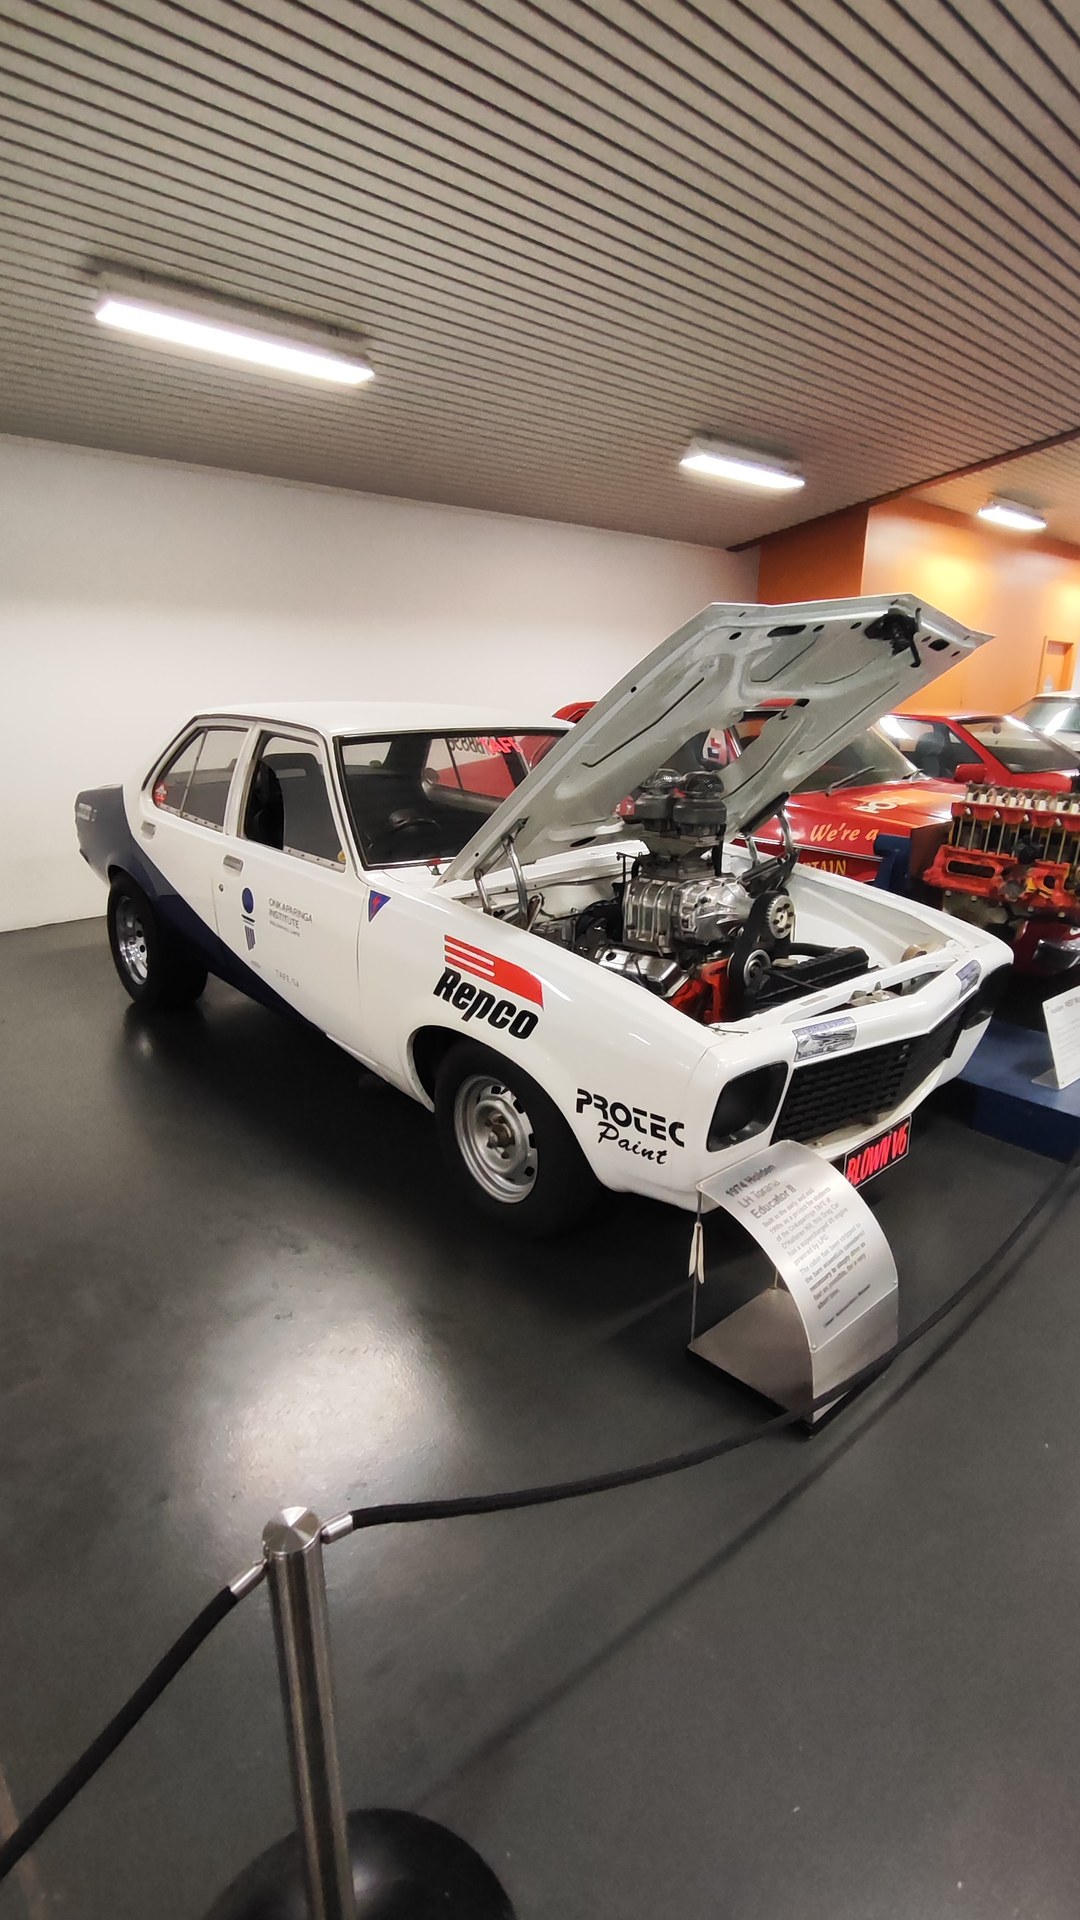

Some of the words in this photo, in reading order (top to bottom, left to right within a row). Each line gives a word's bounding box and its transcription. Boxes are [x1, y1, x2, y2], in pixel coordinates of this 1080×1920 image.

[810, 823, 861, 842] We're
[865, 828, 879, 841] a
[803, 860, 846, 875] TAIN
[269, 898, 313, 923] ONKAPARINGA
[269, 908, 300, 929] INSTITUTE
[433, 967, 539, 1040] Repco
[576, 1089, 685, 1148] PROTEC
[598, 1122, 668, 1164] Paint
[846, 1134, 892, 1186] BLOWN
[892, 1124, 908, 1159] V6
[726, 1182, 748, 1197] 1974
[744, 1165, 776, 1185] Holden
[738, 1194, 756, 1208] LH
[750, 1180, 780, 1199] Torana
[750, 1190, 790, 1219] Educator
[786, 1184, 797, 1194] II
